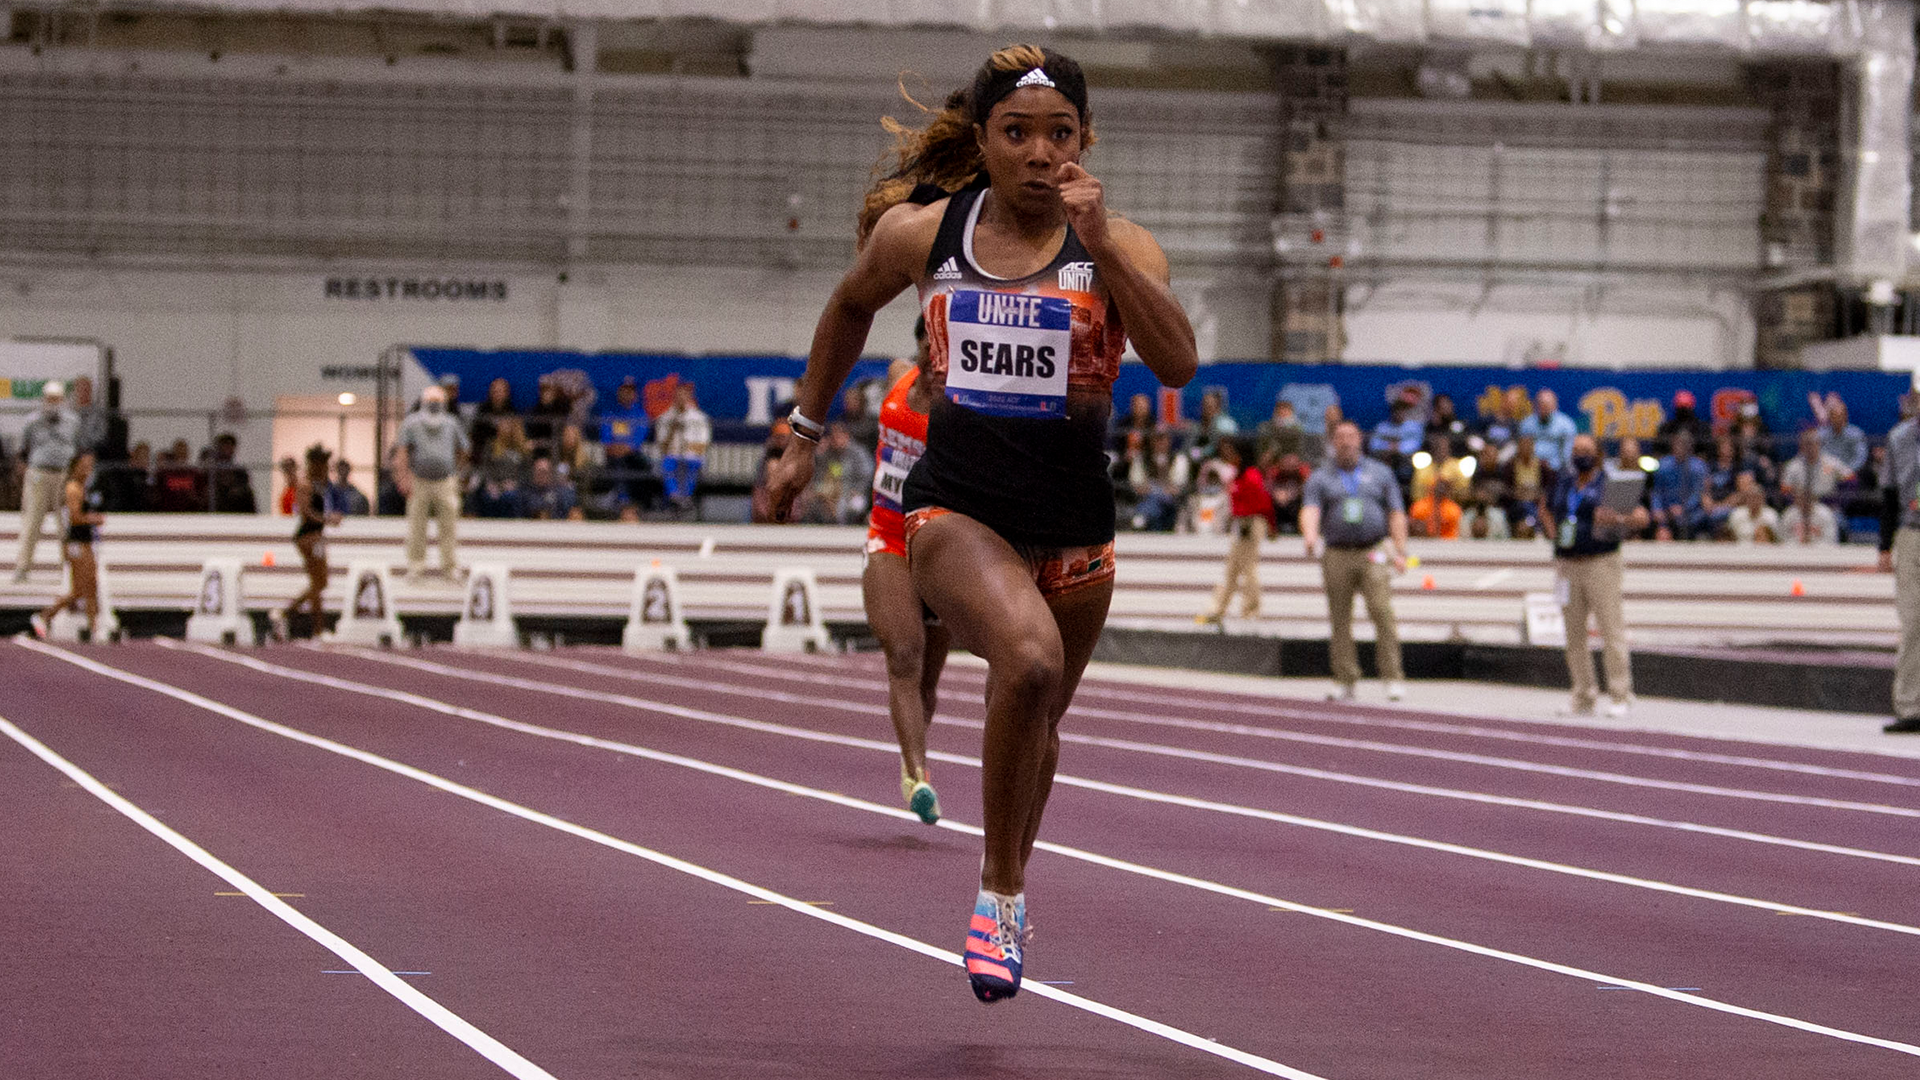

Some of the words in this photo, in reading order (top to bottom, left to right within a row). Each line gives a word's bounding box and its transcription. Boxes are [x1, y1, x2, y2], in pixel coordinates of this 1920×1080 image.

[1016, 78, 1055, 88] adidas
[933, 271, 962, 280] adidas
[1060, 262, 1095, 271] ACC
[324, 278, 507, 299] RESTROOMS
[1058, 270, 1094, 293] UNITY
[978, 293, 1042, 328] UNITE
[961, 339, 1056, 379] SEARS
[358, 580, 380, 614] 4
[646, 588, 667, 620] 2
[788, 590, 806, 622] 1
